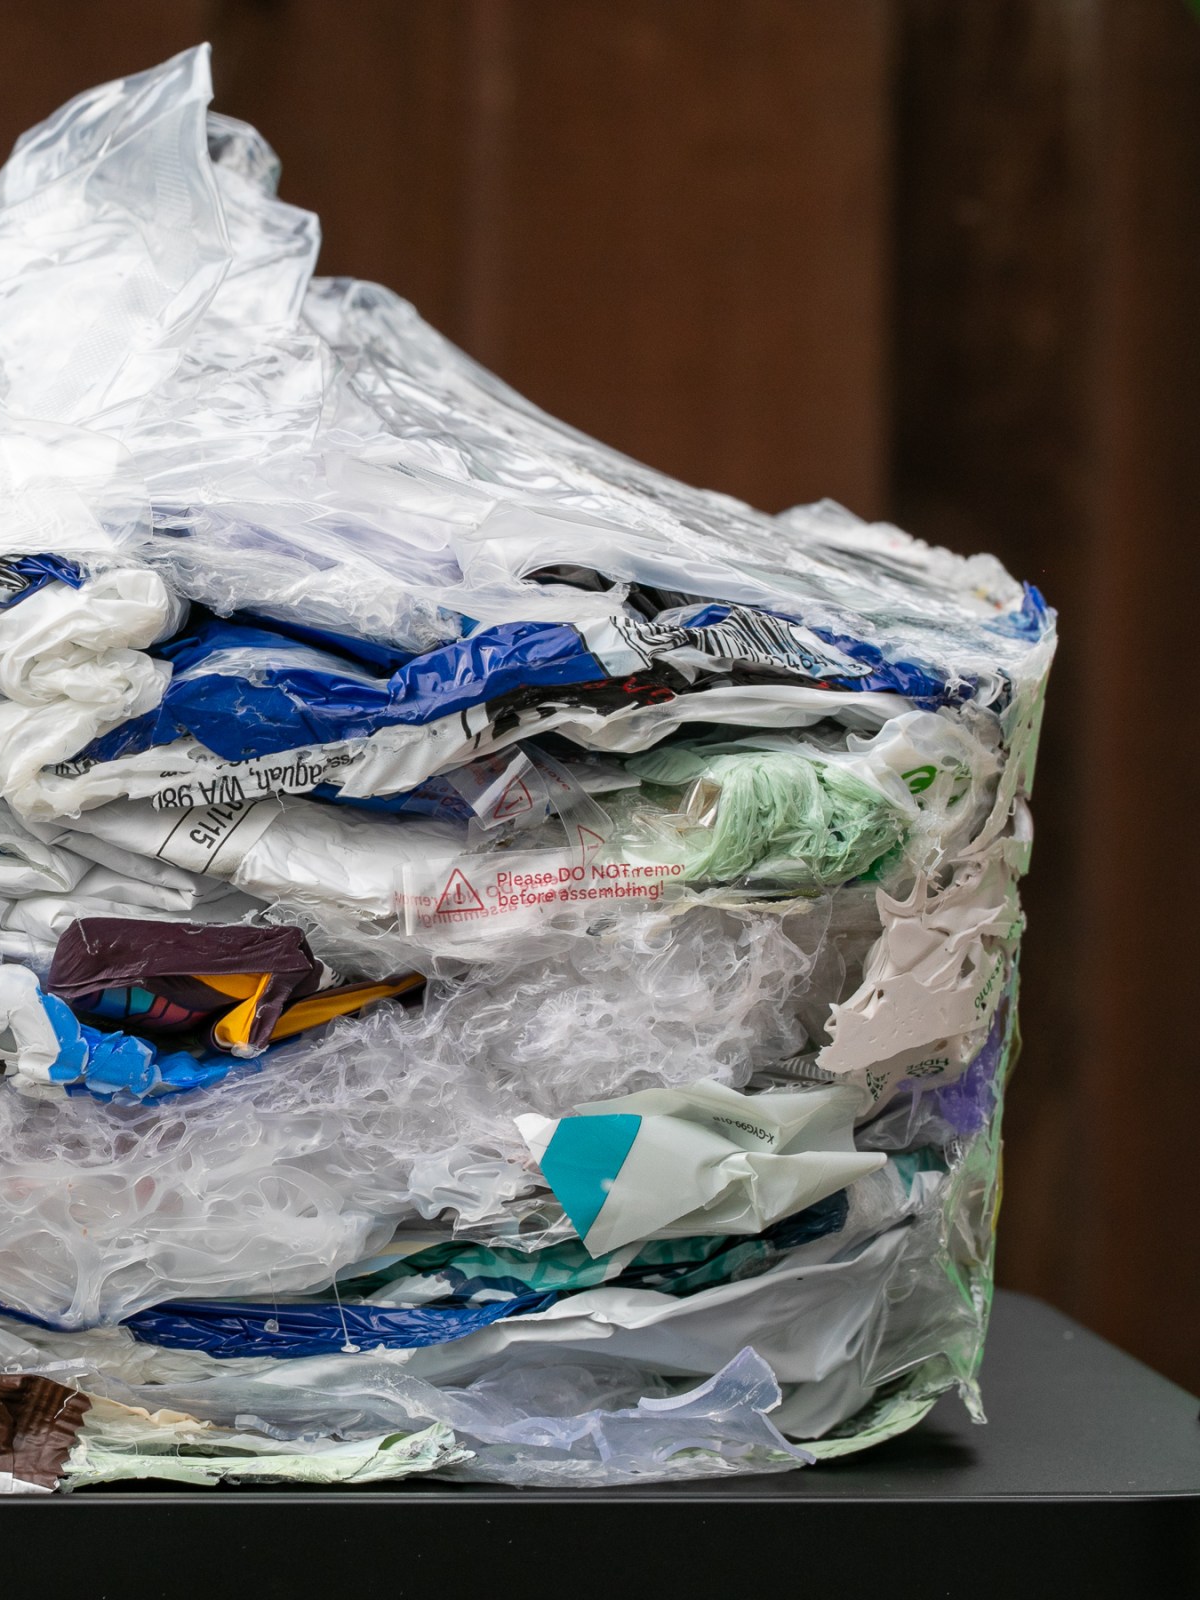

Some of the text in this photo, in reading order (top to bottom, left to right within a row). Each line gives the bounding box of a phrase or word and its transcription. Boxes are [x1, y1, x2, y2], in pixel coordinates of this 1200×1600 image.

[197, 775, 246, 805] WA
[497, 871, 553, 888] Please
[558, 866, 585, 883] DO
[591, 863, 631, 880] NOT
[638, 864, 685, 878] remo
[498, 889, 554, 907] before
[559, 881, 664, 901] assembling!
[905, 1058, 950, 1072] HDPE
